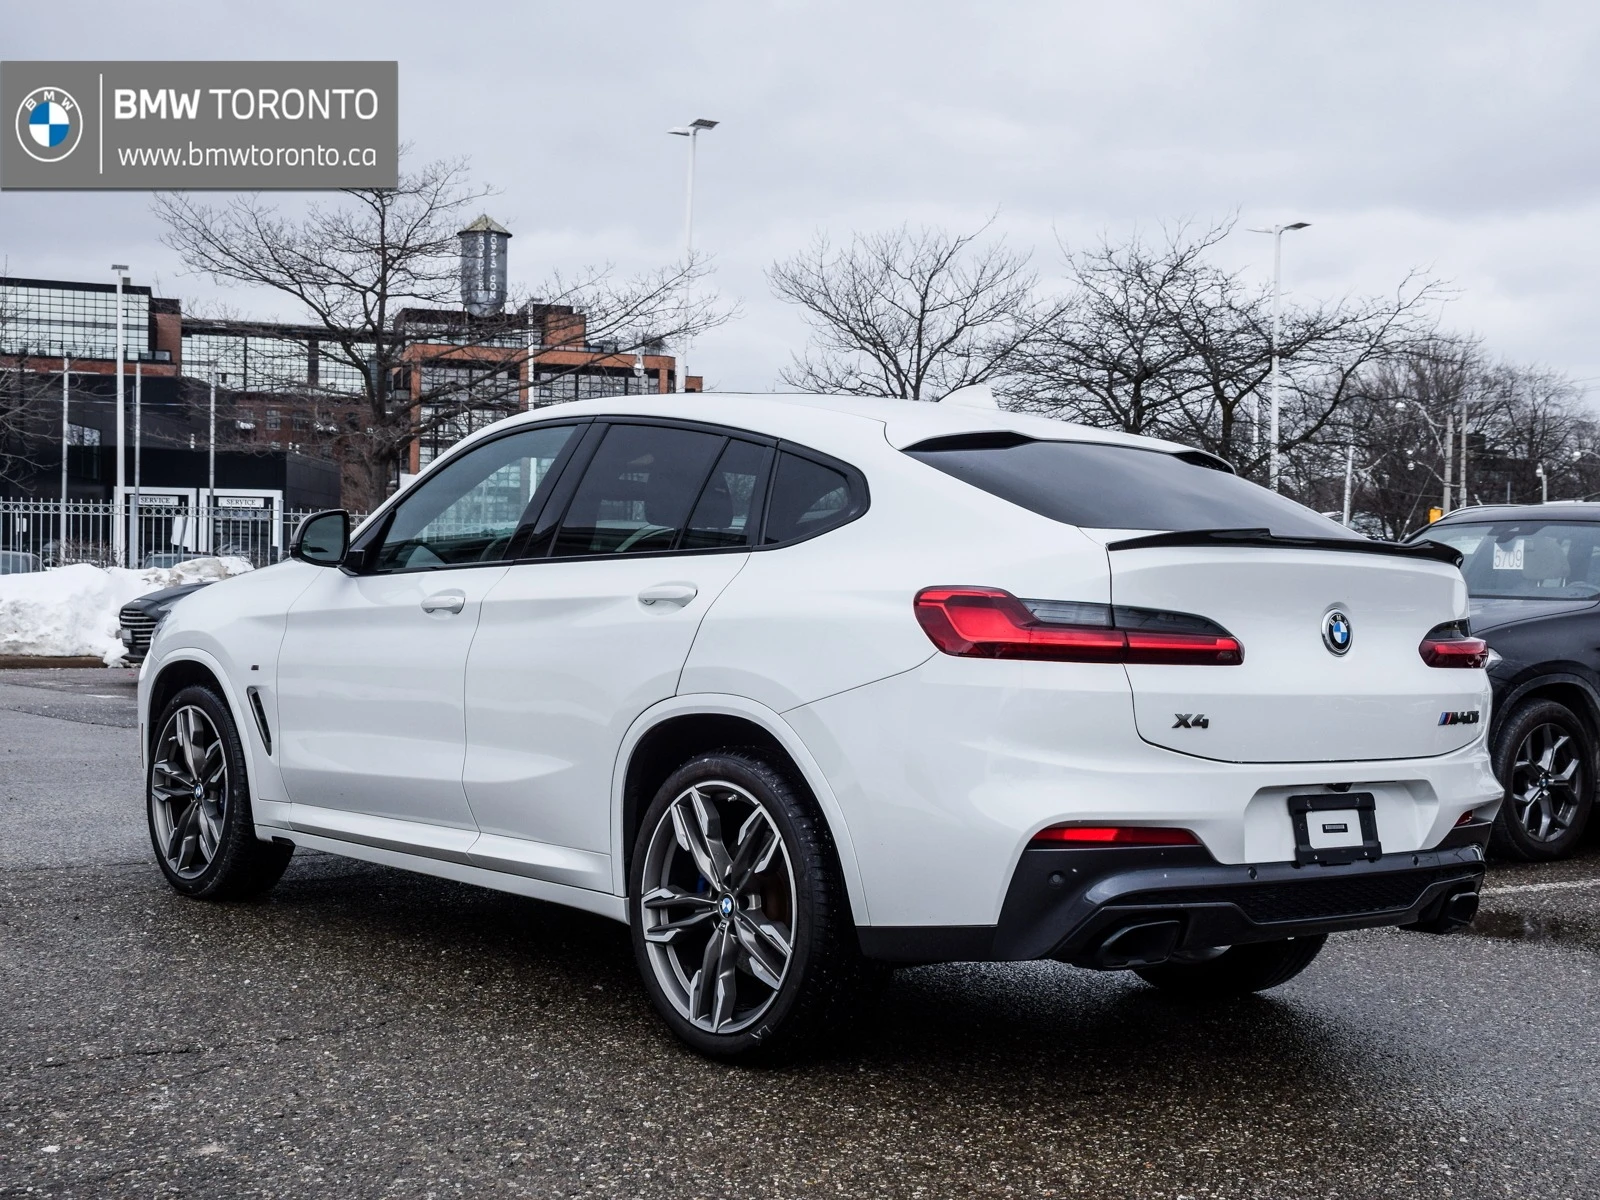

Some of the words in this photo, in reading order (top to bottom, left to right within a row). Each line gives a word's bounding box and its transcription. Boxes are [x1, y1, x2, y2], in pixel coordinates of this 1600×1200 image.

[140, 496, 171, 504] SERVICE
[226, 498, 256, 506] SERVICE
[1495, 549, 1522, 568] 5709
[1171, 713, 1209, 729] X4
